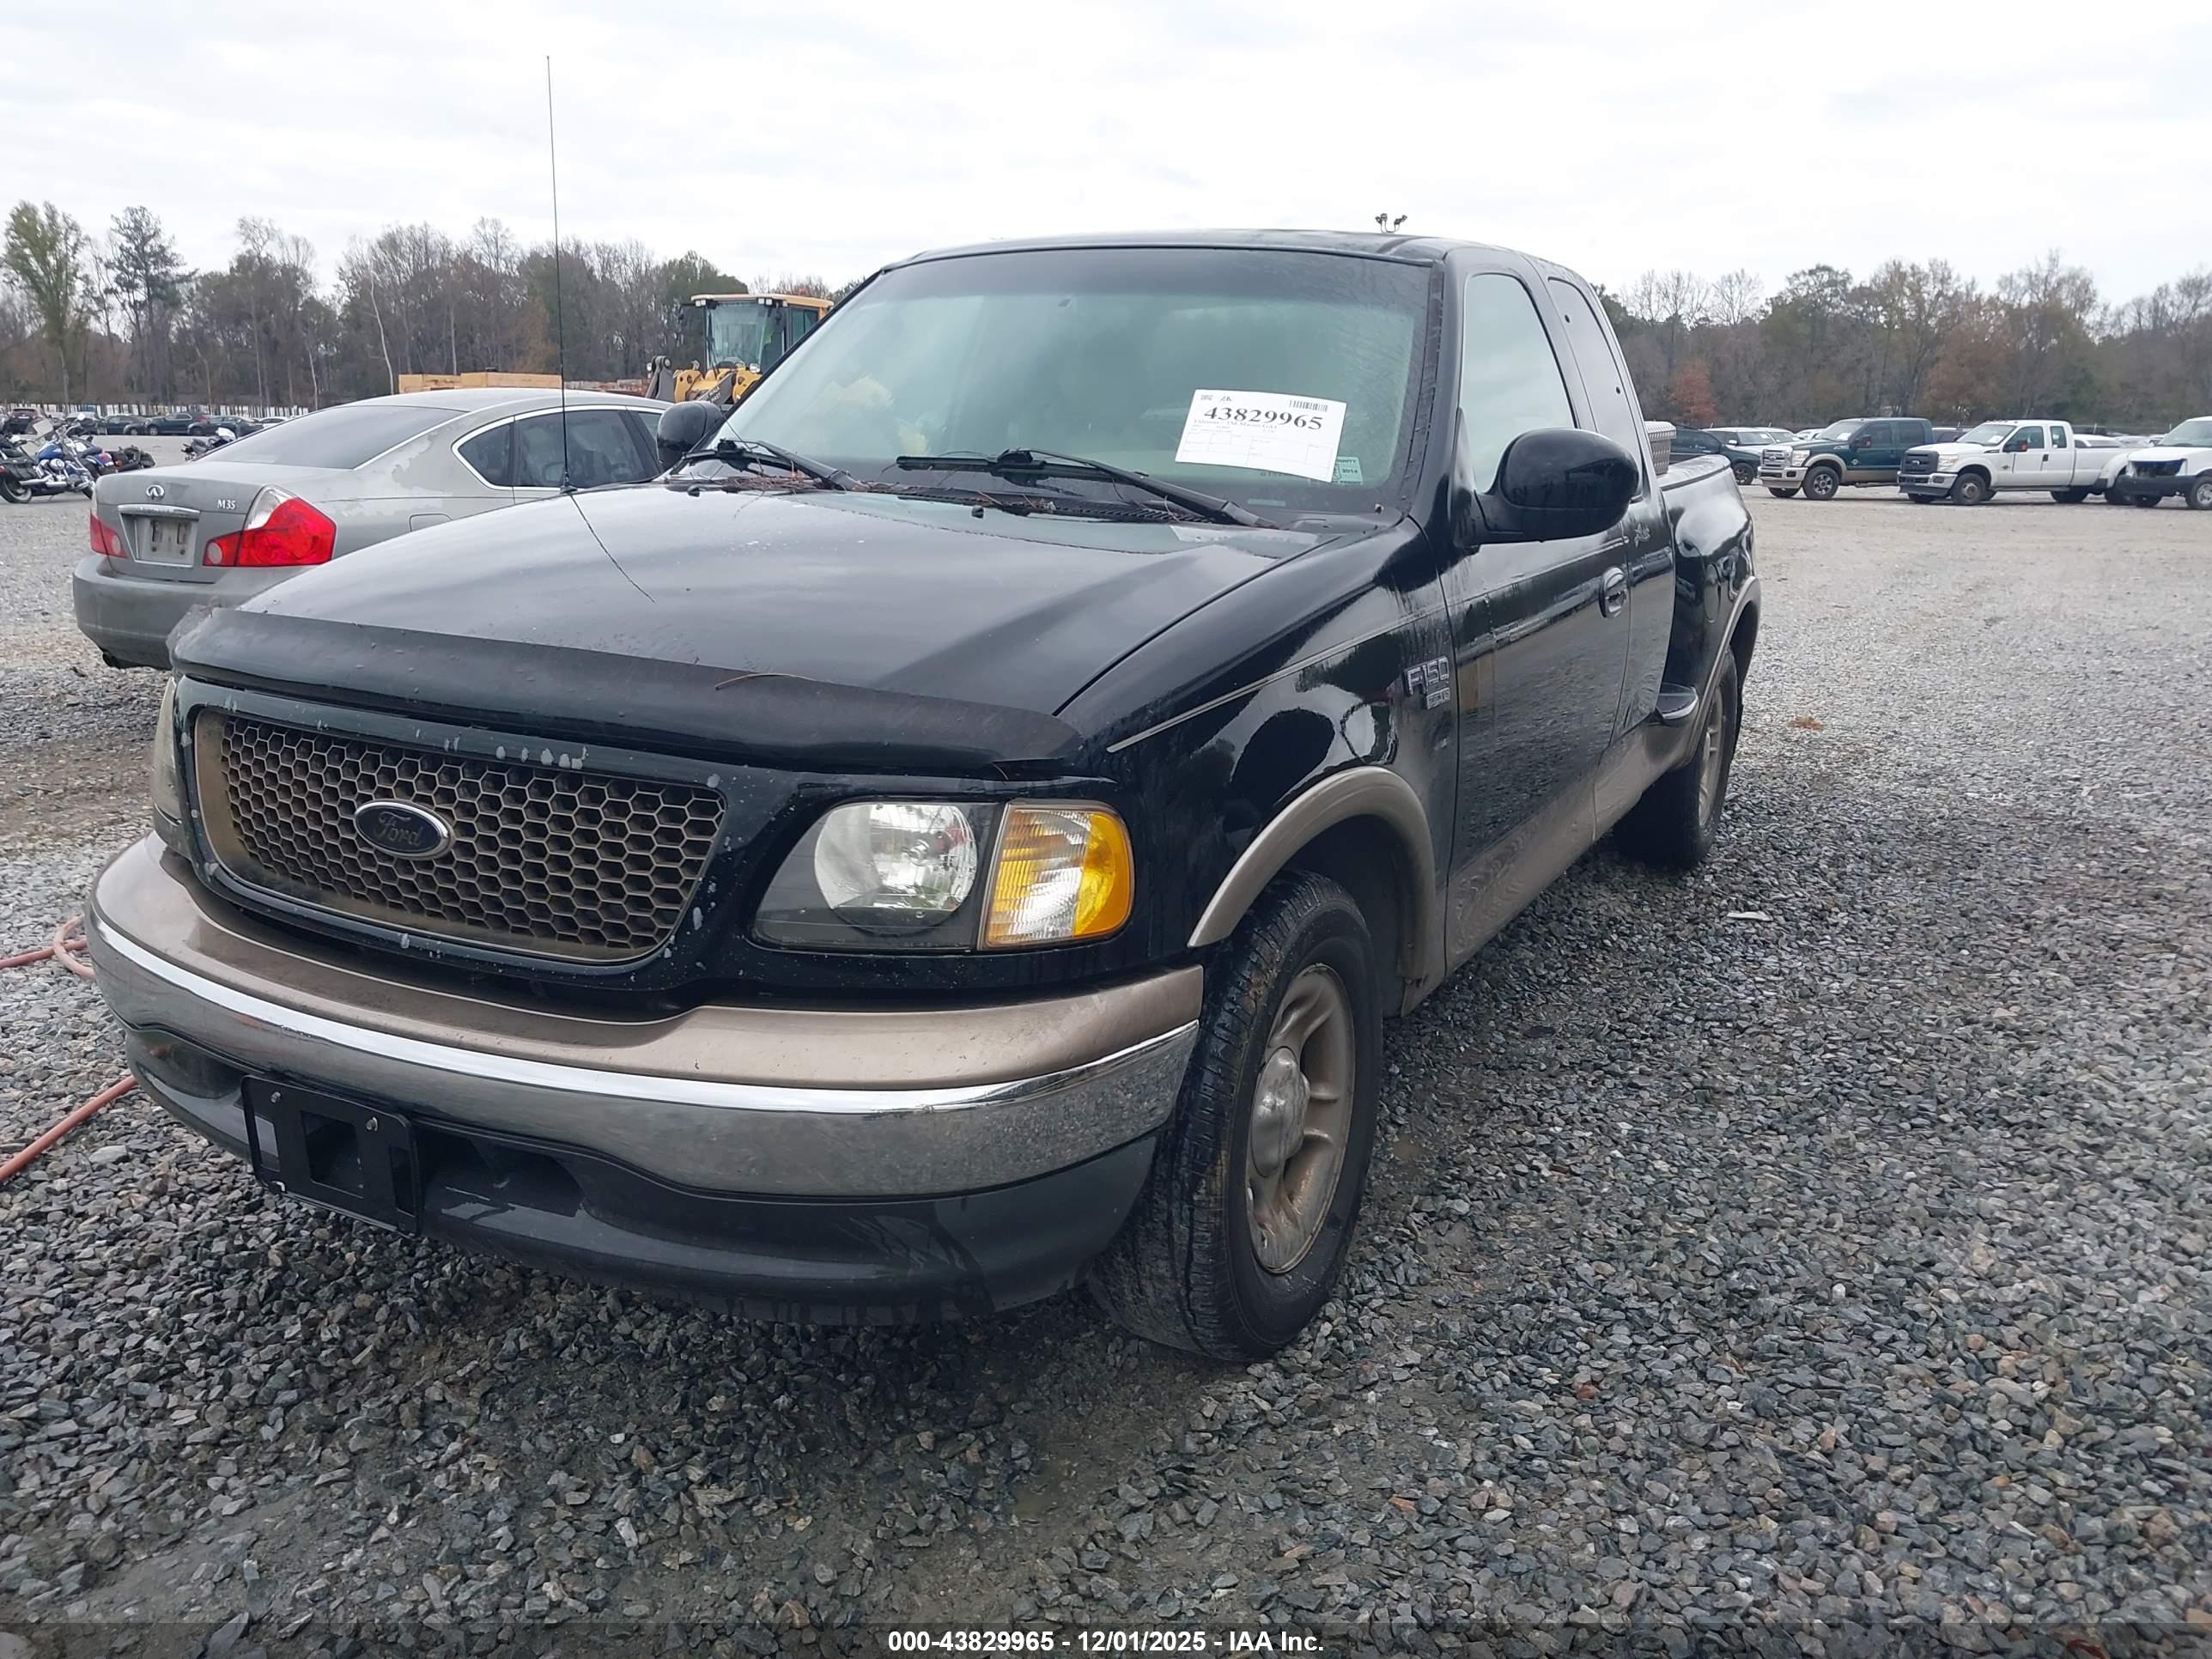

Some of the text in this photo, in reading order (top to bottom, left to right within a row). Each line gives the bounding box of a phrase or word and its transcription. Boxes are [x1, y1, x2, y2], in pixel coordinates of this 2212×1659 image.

[1204, 406, 1324, 430] 43829965
[217, 499, 237, 510] M35
[373, 811, 424, 847] Ford
